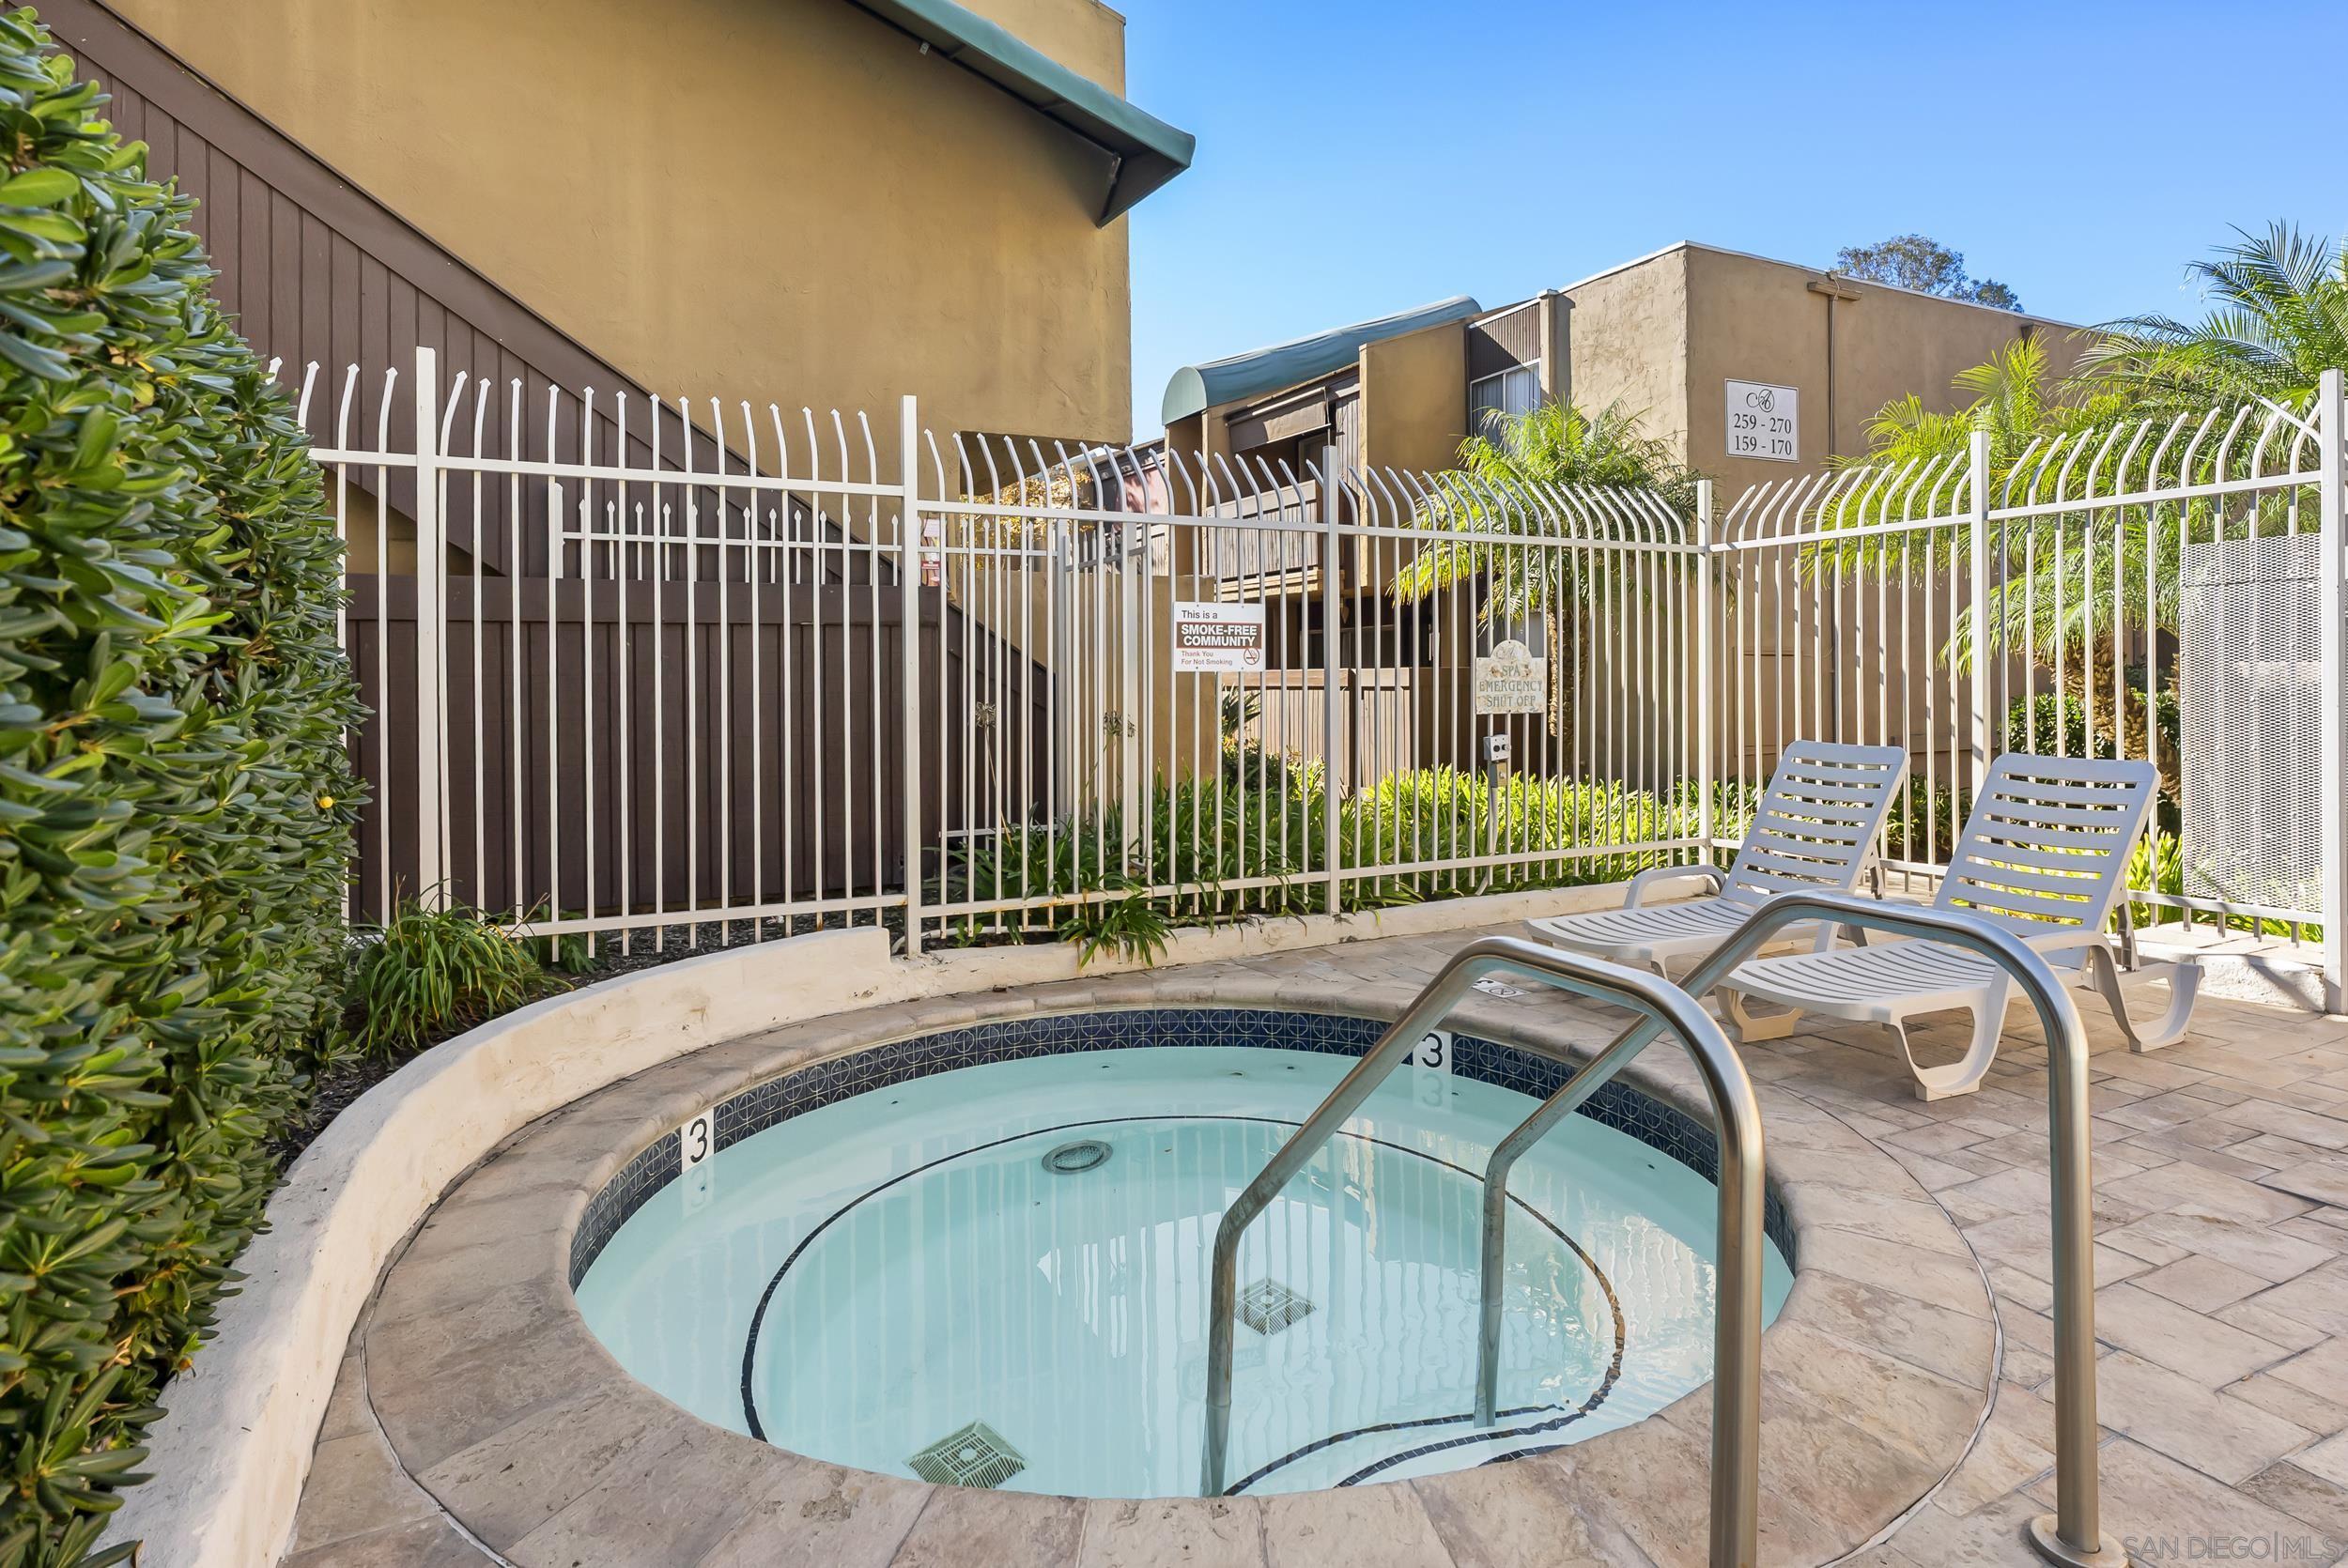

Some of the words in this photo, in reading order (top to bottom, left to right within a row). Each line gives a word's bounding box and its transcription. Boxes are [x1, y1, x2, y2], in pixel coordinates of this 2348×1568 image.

[1734, 413, 1757, 430] 259
[1769, 417, 1792, 434] 270
[1735, 435, 1757, 452] 159
[1771, 438, 1792, 455] 170
[1182, 609, 1200, 619] This
[1202, 610, 1210, 619] is
[1182, 624, 1258, 636] SMOKE-FREE
[1183, 636, 1256, 646] COMMUNITY
[1503, 665, 1521, 677] SPA
[1479, 680, 1543, 693] EMERGENCY
[1487, 696, 1513, 708] SHUT
[1421, 1032, 1444, 1068] 3
[689, 1117, 708, 1163] 3
